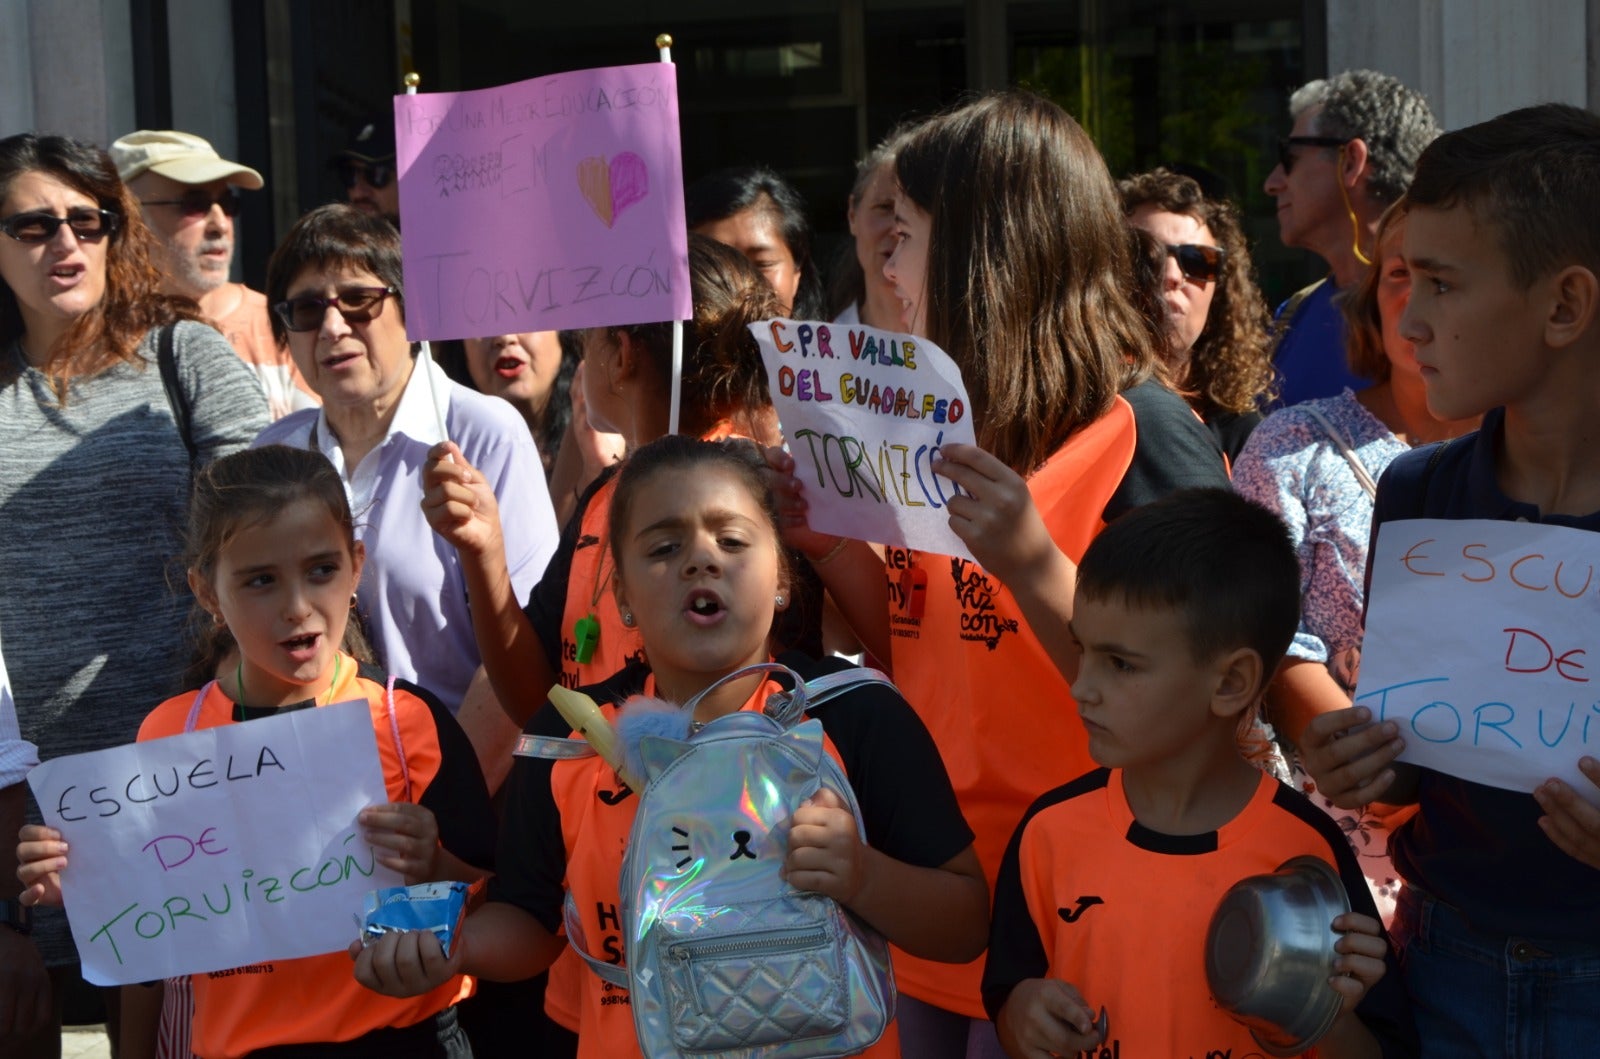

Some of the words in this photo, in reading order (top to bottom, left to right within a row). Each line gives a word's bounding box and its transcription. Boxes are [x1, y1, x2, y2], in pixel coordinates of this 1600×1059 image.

[544, 78, 671, 118] EDUCACIÓN
[500, 133, 549, 198] EN
[413, 250, 673, 328] TORVIZCÓN
[770, 321, 840, 359] C.P.R.
[848, 329, 918, 370] VALLE
[778, 365, 832, 401] DEL
[839, 372, 964, 424] GUADALFEO
[1400, 538, 1594, 599] ESCU
[1502, 627, 1590, 682] DE
[56, 746, 286, 822] ESCUELA
[141, 827, 229, 871] DE
